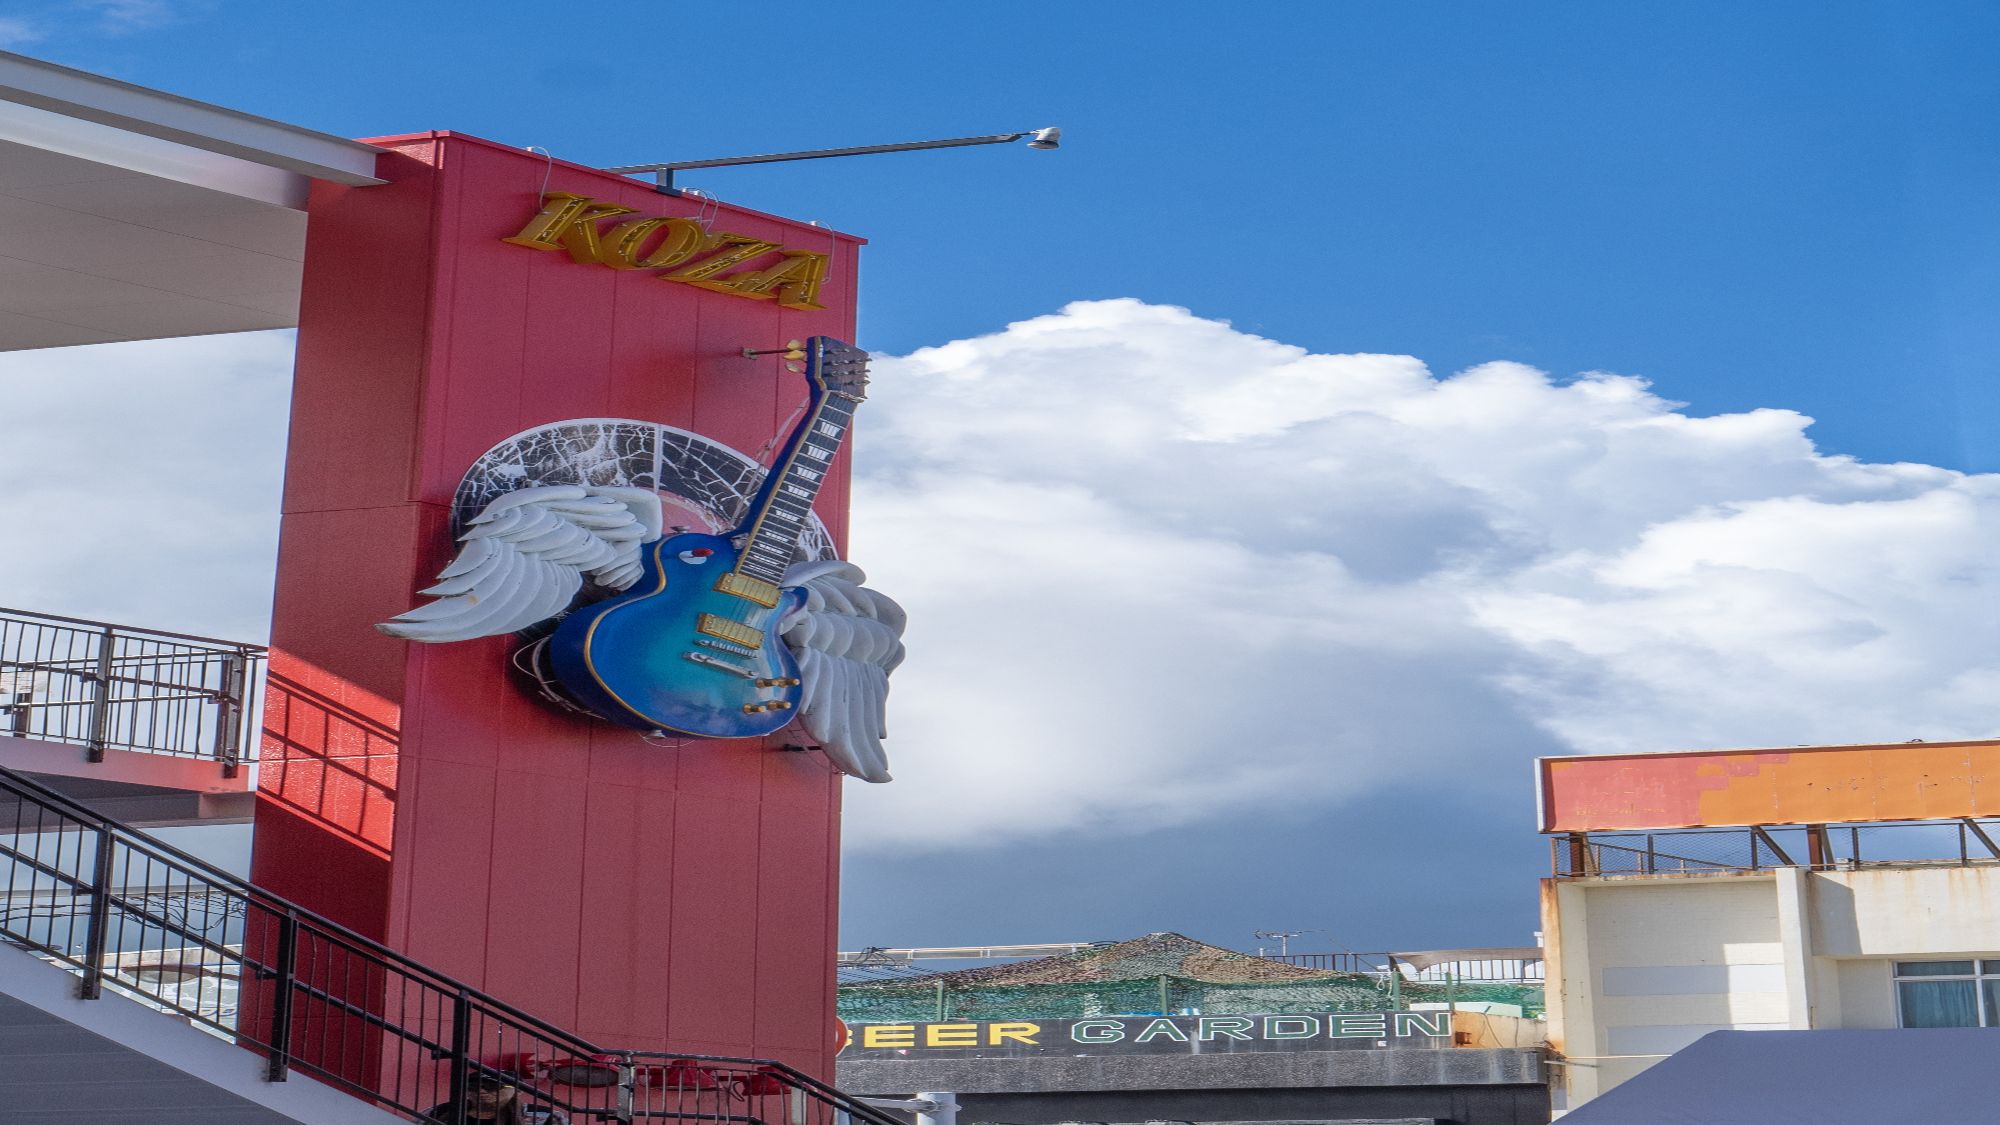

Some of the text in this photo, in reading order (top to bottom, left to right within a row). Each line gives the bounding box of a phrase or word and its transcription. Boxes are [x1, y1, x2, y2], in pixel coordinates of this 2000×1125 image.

[502, 192, 829, 310] KOZA
[846, 1013, 1452, 1048] EER GARDEN
